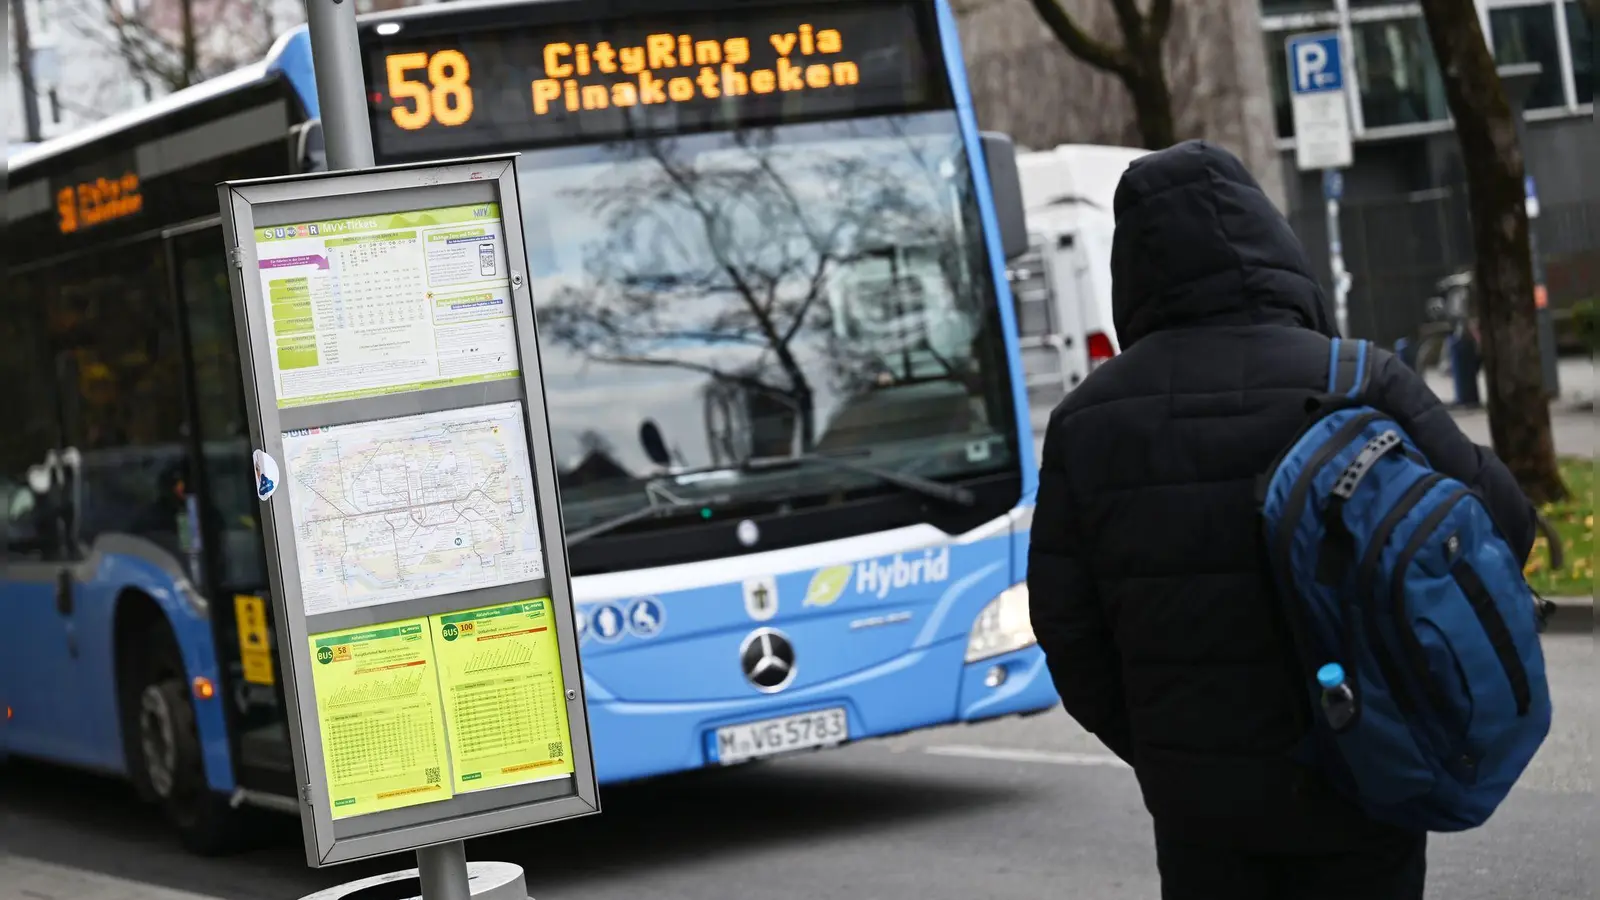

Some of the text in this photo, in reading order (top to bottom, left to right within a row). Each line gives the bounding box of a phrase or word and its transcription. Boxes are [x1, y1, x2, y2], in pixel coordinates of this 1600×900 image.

[384, 24, 843, 130] 58 CityRing via
[1296, 42, 1329, 90] P
[531, 58, 860, 116] Pinakotheken
[473, 206, 488, 218] MVV
[265, 229, 273, 239] S
[276, 228, 285, 238] U
[309, 225, 318, 235] R
[322, 220, 377, 233] MVV-Tickets
[856, 547, 949, 600] Hybrid
[443, 627, 458, 637] BUS
[460, 623, 473, 632] 100
[318, 651, 332, 661] BUS
[338, 646, 347, 655] 58
